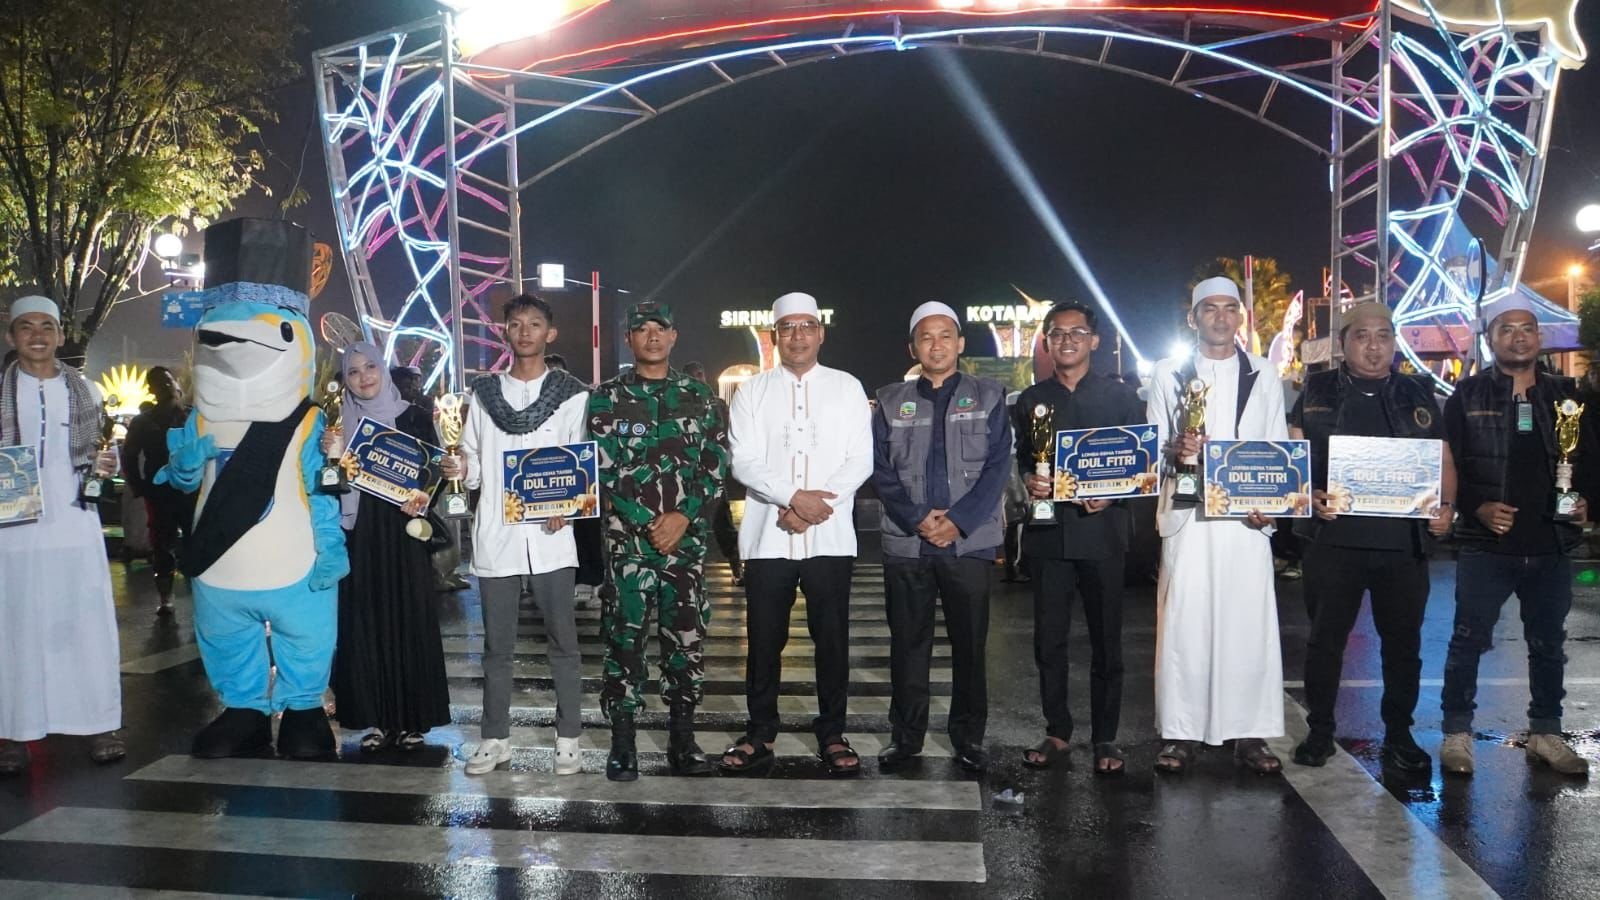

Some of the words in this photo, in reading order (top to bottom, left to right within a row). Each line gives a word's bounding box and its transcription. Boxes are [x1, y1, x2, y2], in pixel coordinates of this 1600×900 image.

[367, 450, 390, 468] IDUL
[391, 461, 420, 480] FITRI
[1077, 457, 1105, 469] IDUL
[1106, 455, 1136, 467] FITRI
[1228, 472, 1256, 483] IDUL
[1257, 472, 1288, 483] FITRI
[1353, 469, 1378, 481] IDUL
[1384, 471, 1416, 482] FITRI
[361, 473, 396, 492] TERBAIK
[523, 477, 548, 490] IDUL
[549, 475, 577, 488] FITRI
[1080, 481, 1122, 489] TERBAIK
[527, 502, 565, 512] TERBAIK
